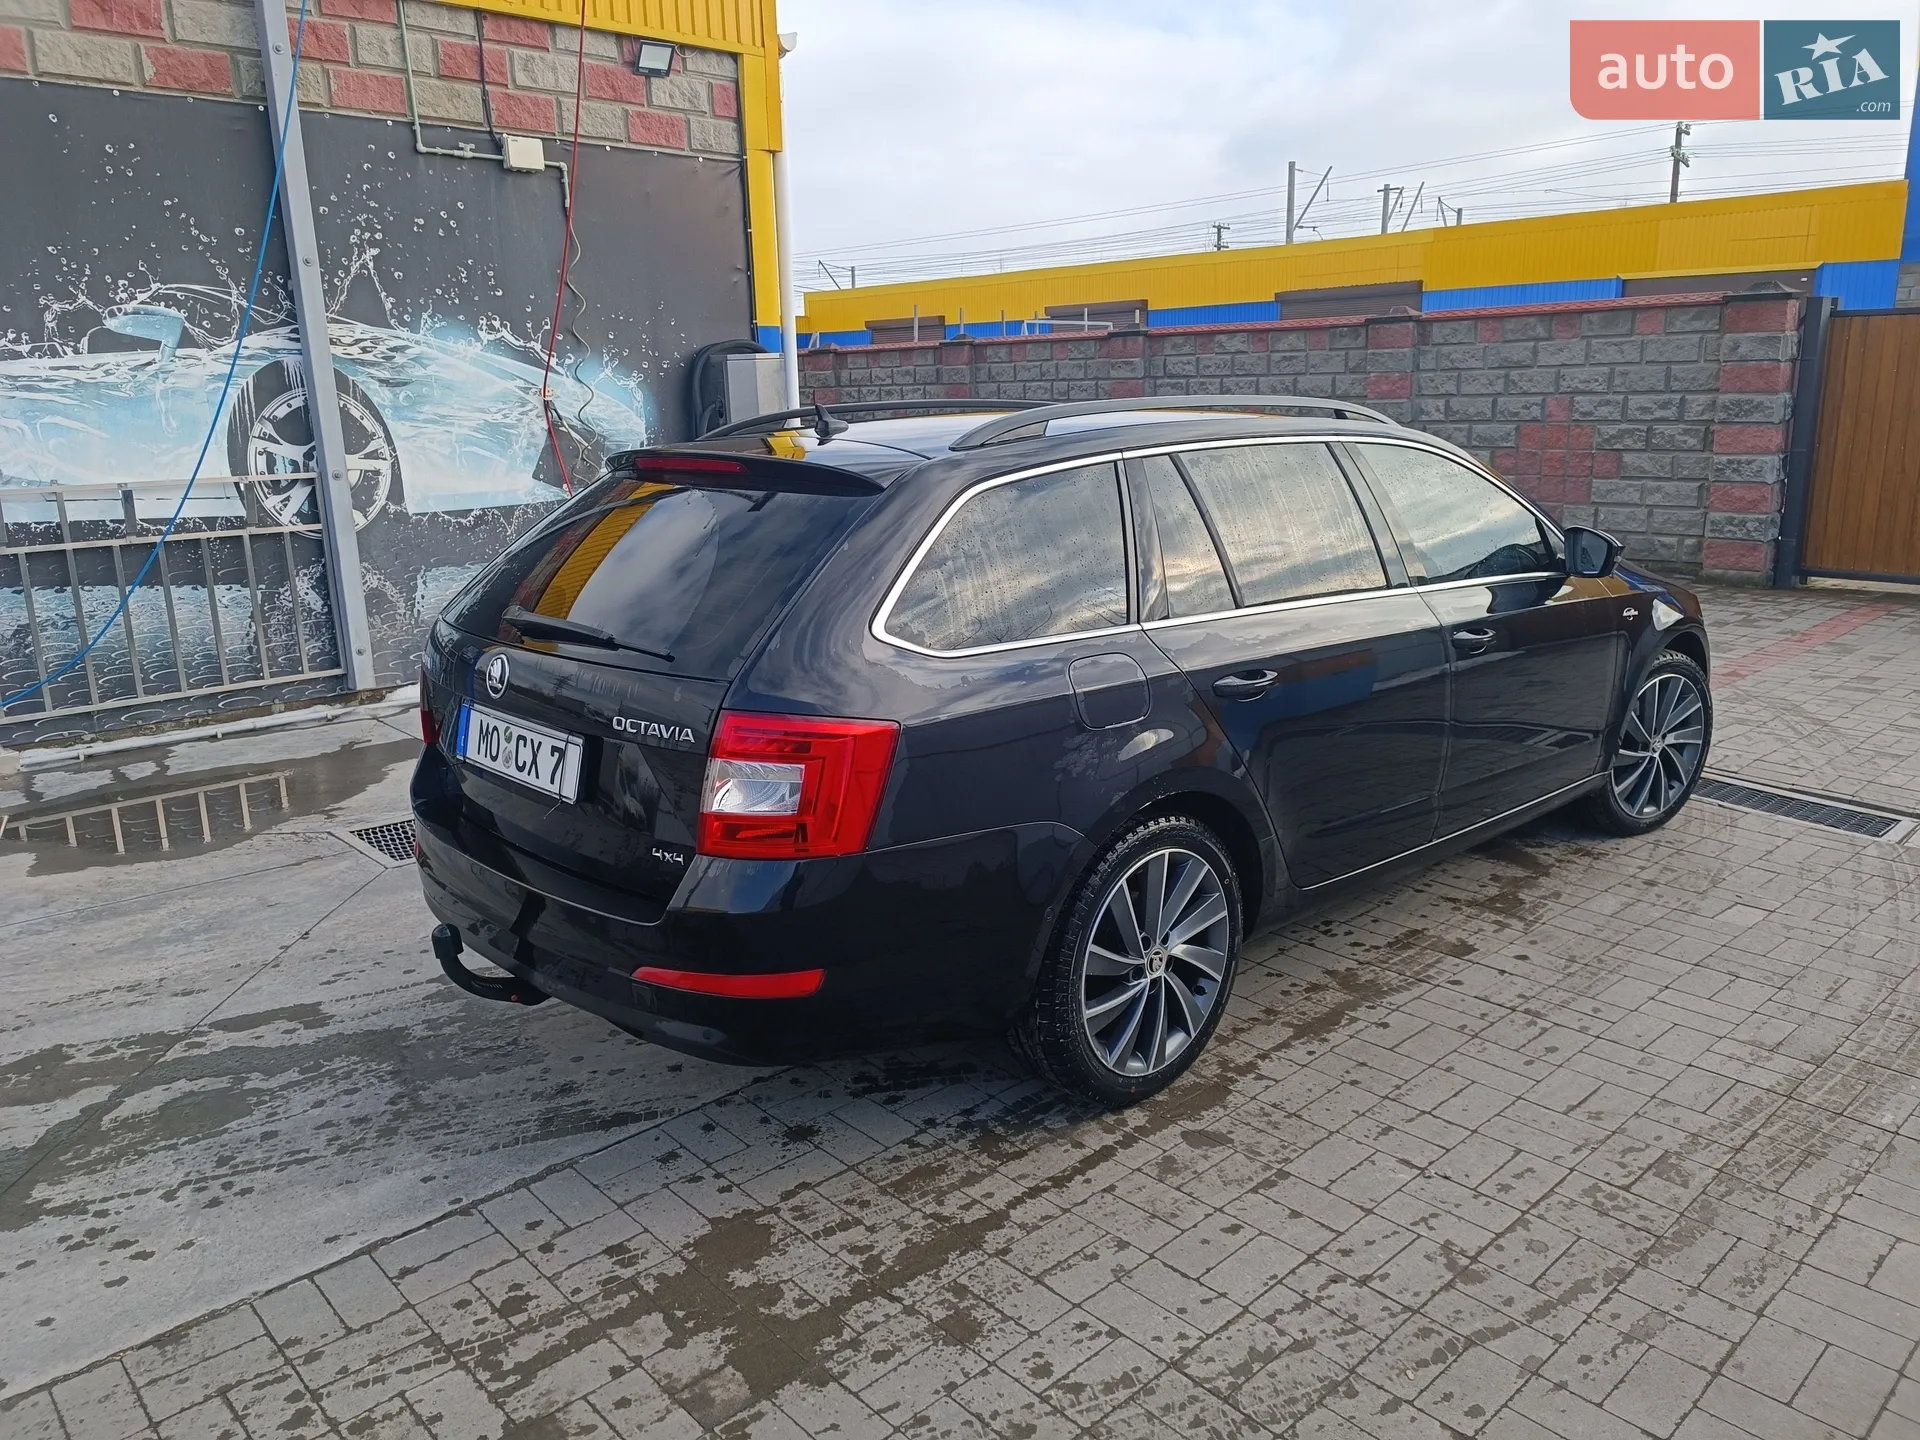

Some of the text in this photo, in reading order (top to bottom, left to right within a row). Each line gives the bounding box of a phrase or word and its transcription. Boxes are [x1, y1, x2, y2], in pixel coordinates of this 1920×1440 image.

[612, 716, 696, 743] OCTAVIA
[515, 734, 543, 779] CX
[550, 745, 565, 785] 7
